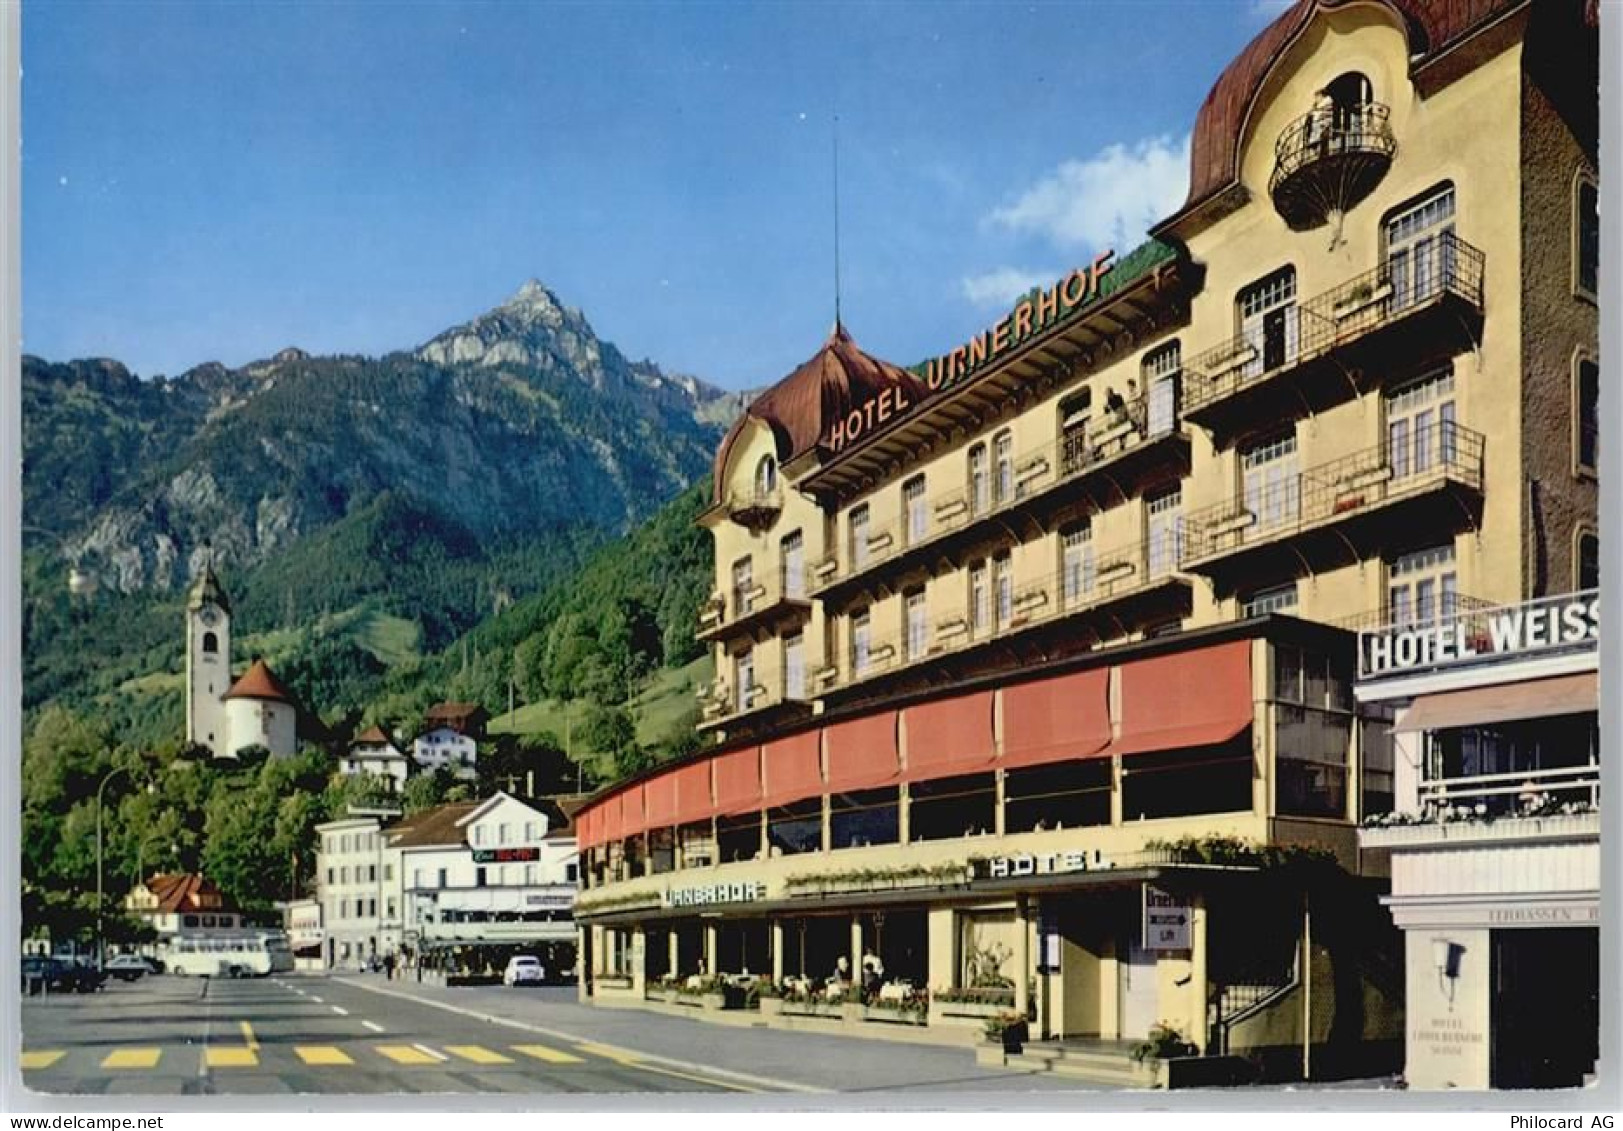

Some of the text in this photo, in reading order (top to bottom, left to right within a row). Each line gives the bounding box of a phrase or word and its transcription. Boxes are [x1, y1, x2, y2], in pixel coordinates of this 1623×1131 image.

[829, 249, 1113, 452] HOTEL URNERHOF
[1370, 621, 1476, 673] HOTEL
[990, 849, 1111, 877] HOTEL
